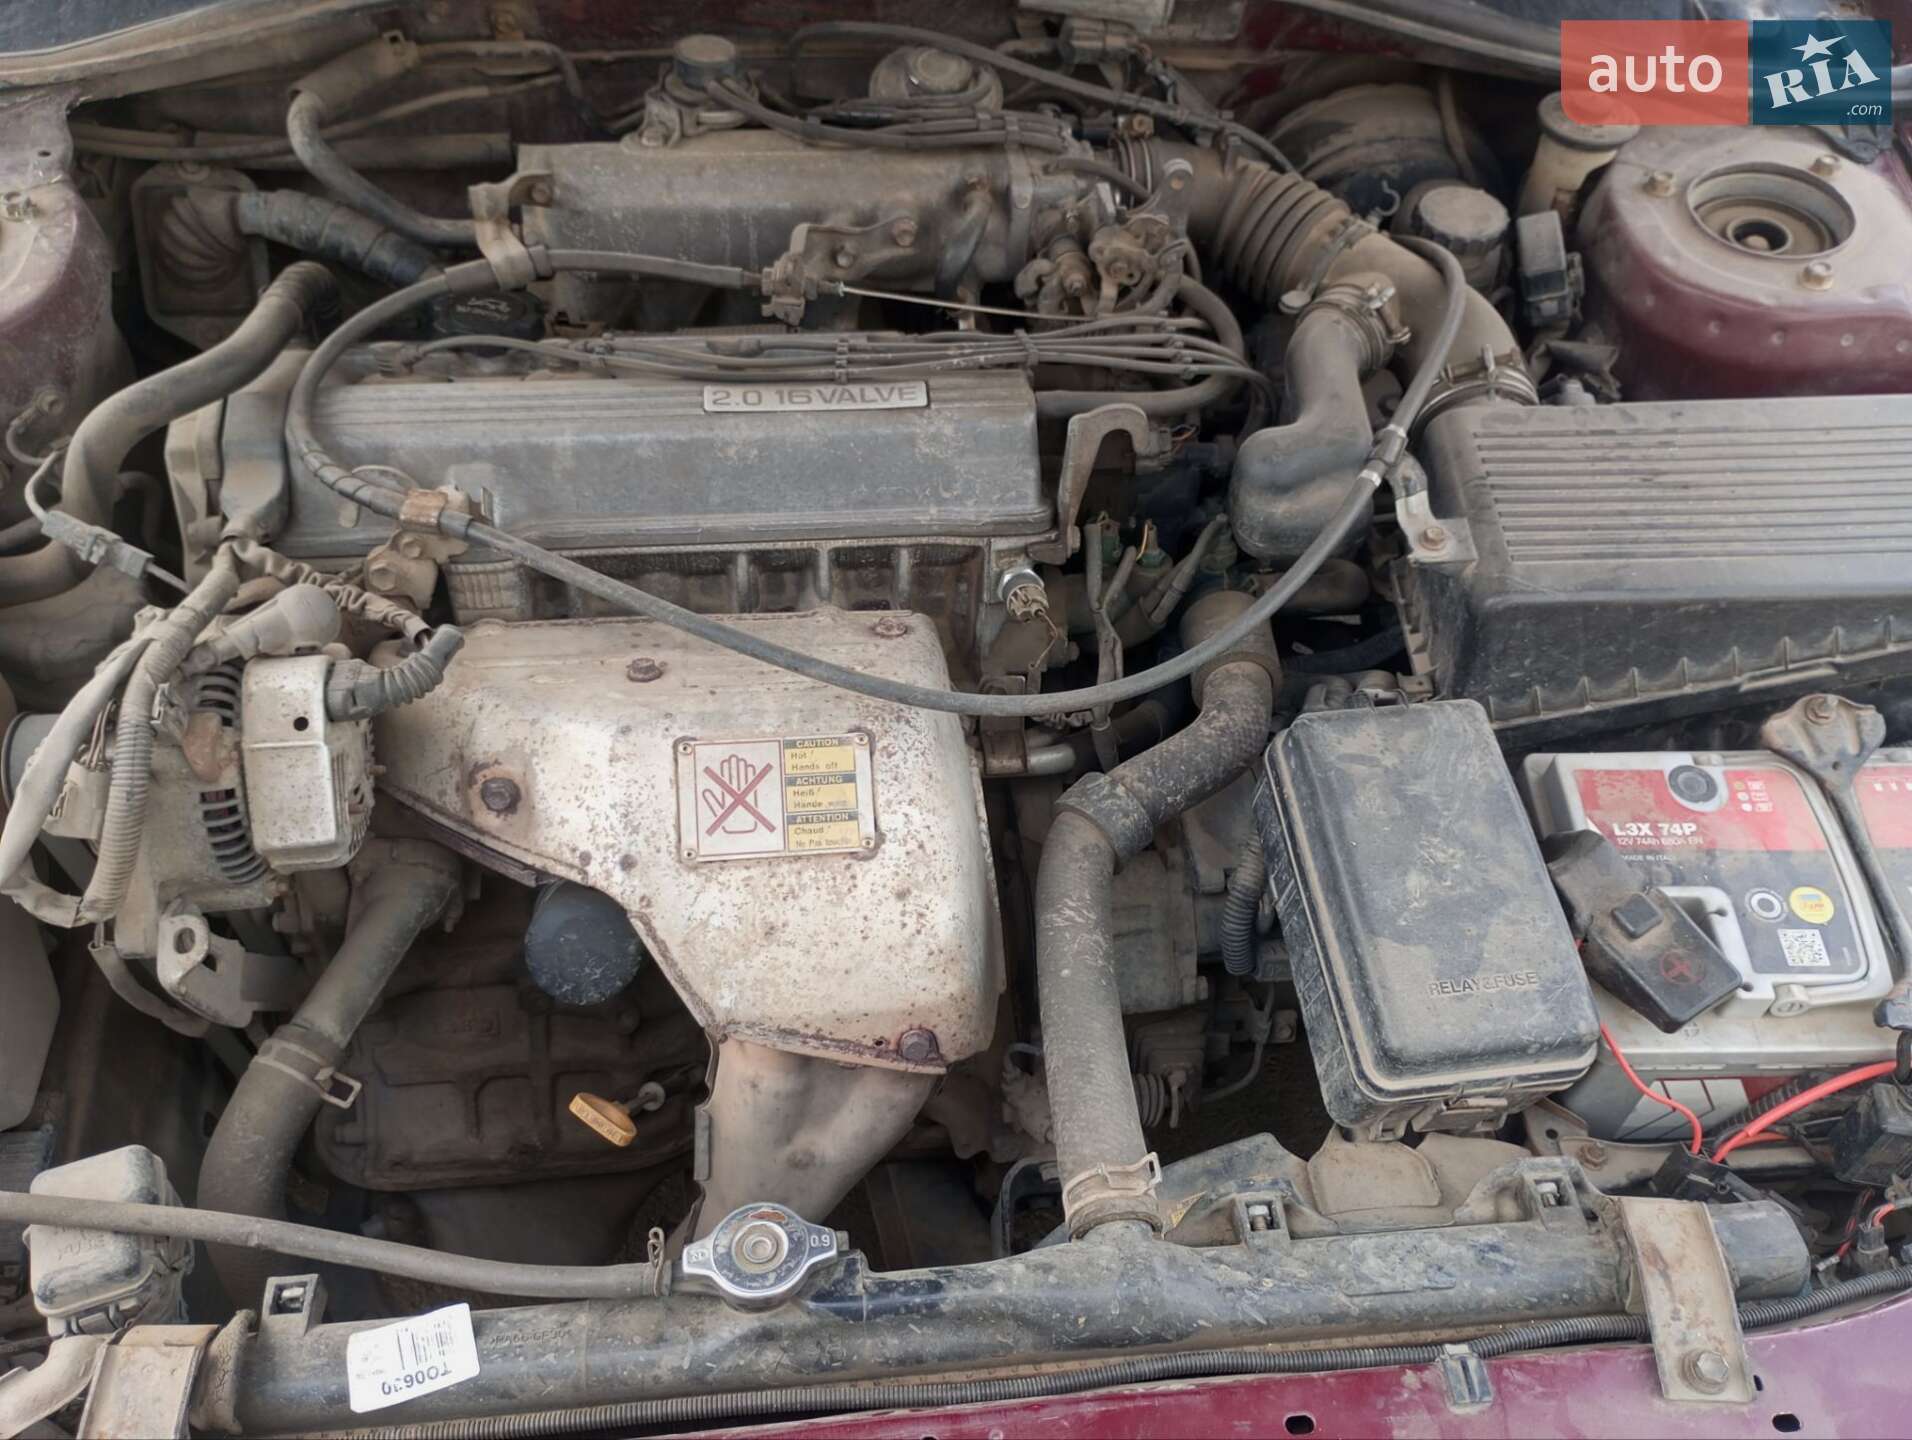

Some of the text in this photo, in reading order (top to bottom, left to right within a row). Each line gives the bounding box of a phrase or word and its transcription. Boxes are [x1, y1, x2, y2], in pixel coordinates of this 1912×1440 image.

[711, 389, 761, 407] 2.0
[796, 738, 839, 749] CAUTION
[791, 763, 820, 772] Hands
[796, 774, 844, 786] ACHTUNG
[796, 812, 850, 825] ATTENTION
[1612, 822, 1697, 837] L3X 74P
[1617, 836, 1634, 845] 12V
[809, 1234, 831, 1248] 0.9
